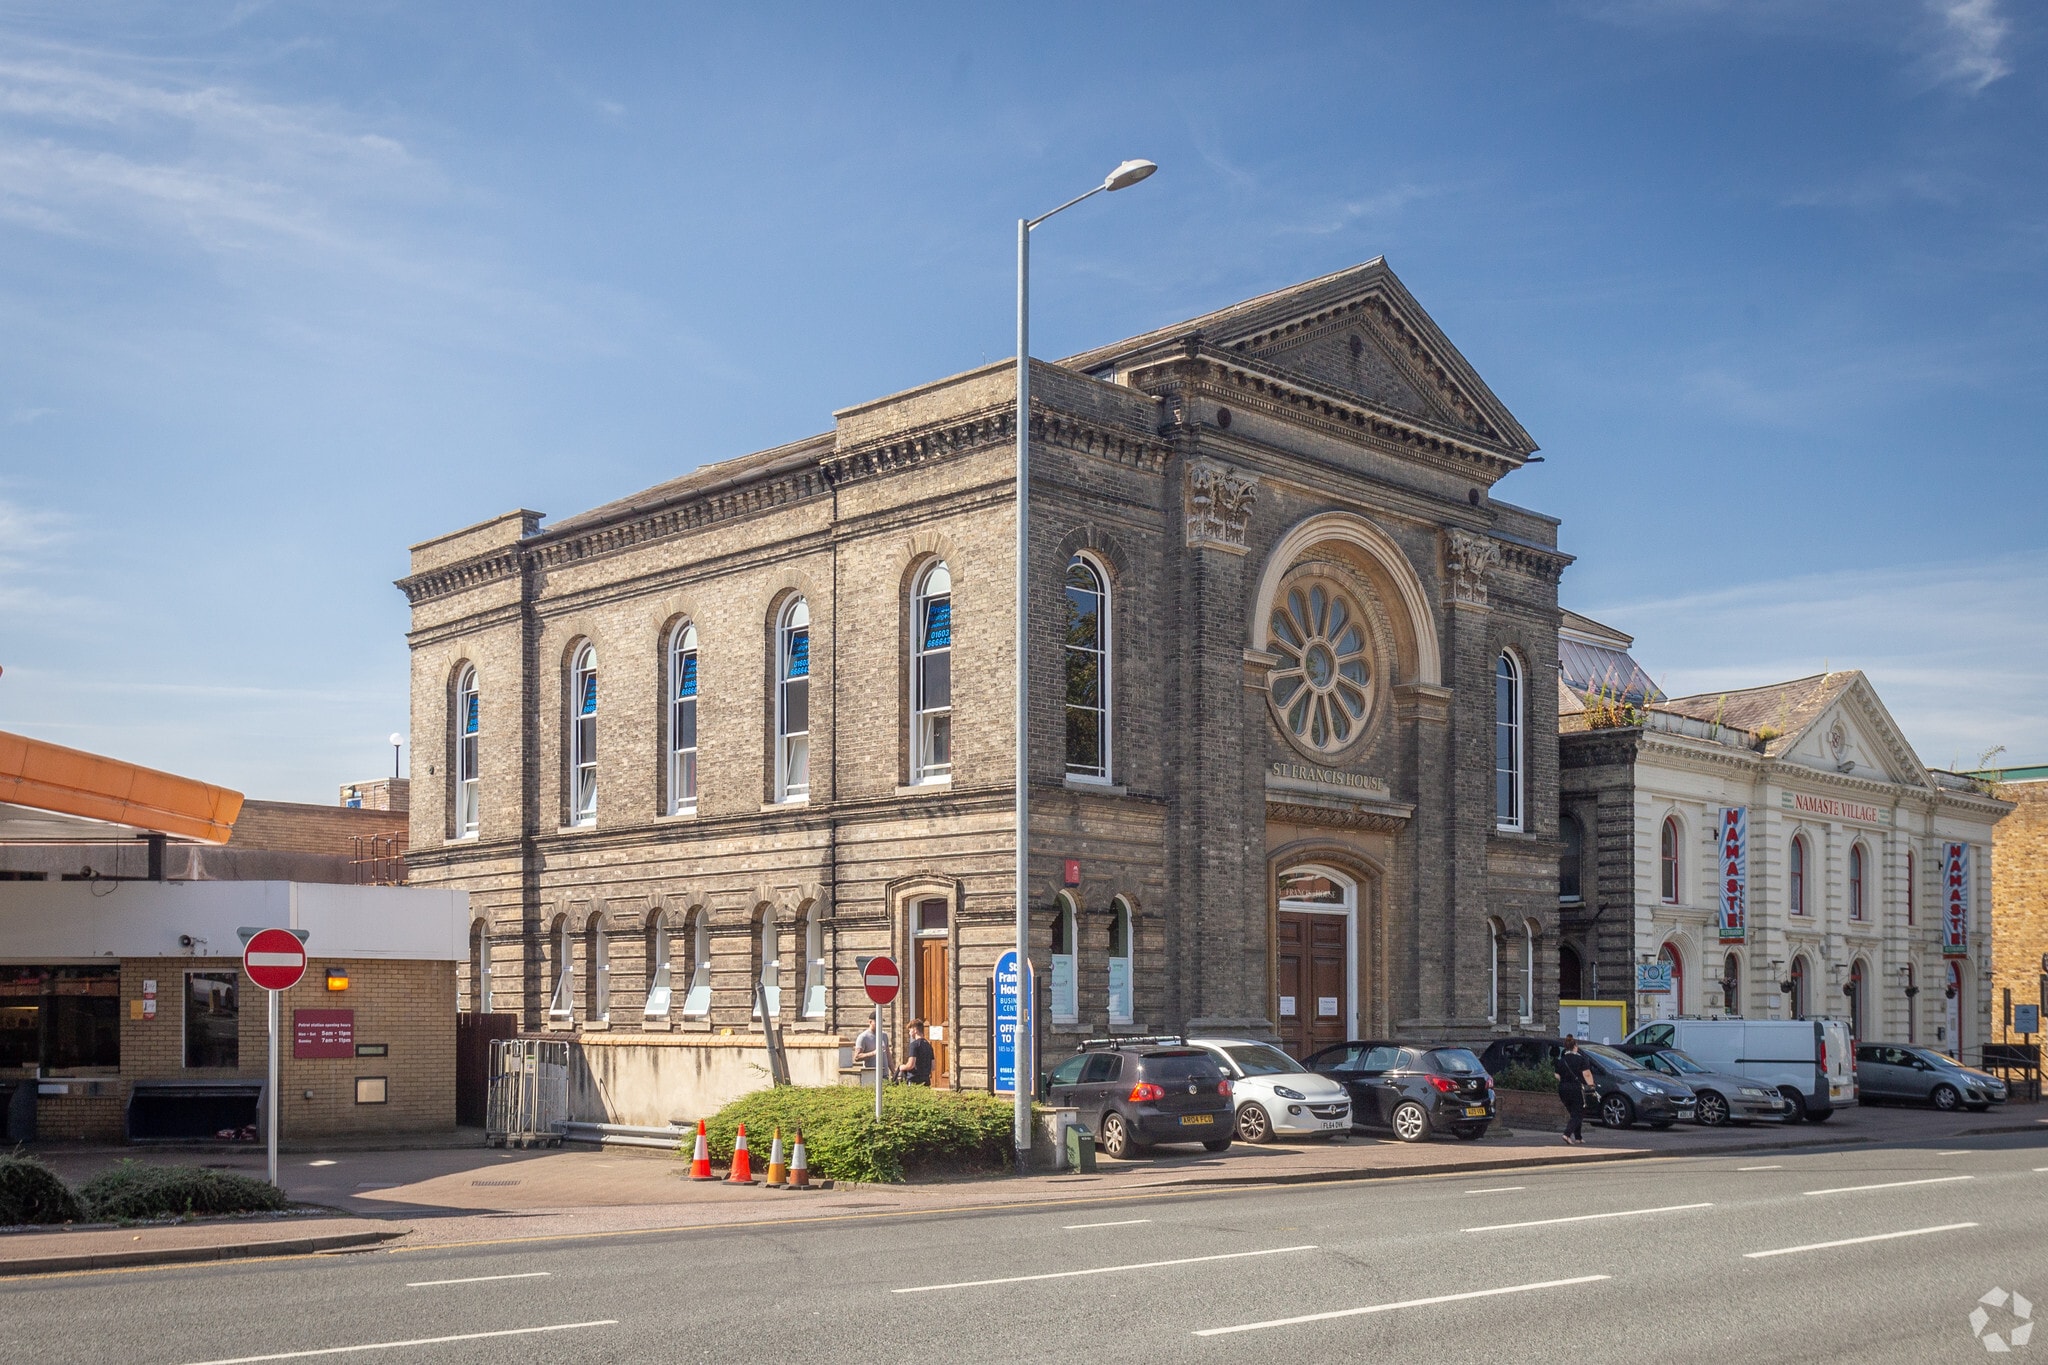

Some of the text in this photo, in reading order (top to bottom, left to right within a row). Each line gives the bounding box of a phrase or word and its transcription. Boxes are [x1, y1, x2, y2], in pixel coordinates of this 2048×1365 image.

[931, 629, 950, 639] 01603
[1273, 763, 1384, 791] ST FRANCIS HOUSE
[1795, 794, 1839, 816] NAMASTE
[1841, 803, 1877, 822] VILLAGE
[1726, 810, 1739, 928] NAMASTE
[1950, 845, 1962, 945] NAMASTE
[999, 972, 1017, 983] Fran
[1000, 984, 1017, 995] Hou
[1000, 997, 1017, 1005] BUSIN
[1001, 1034, 1012, 1043] TO
